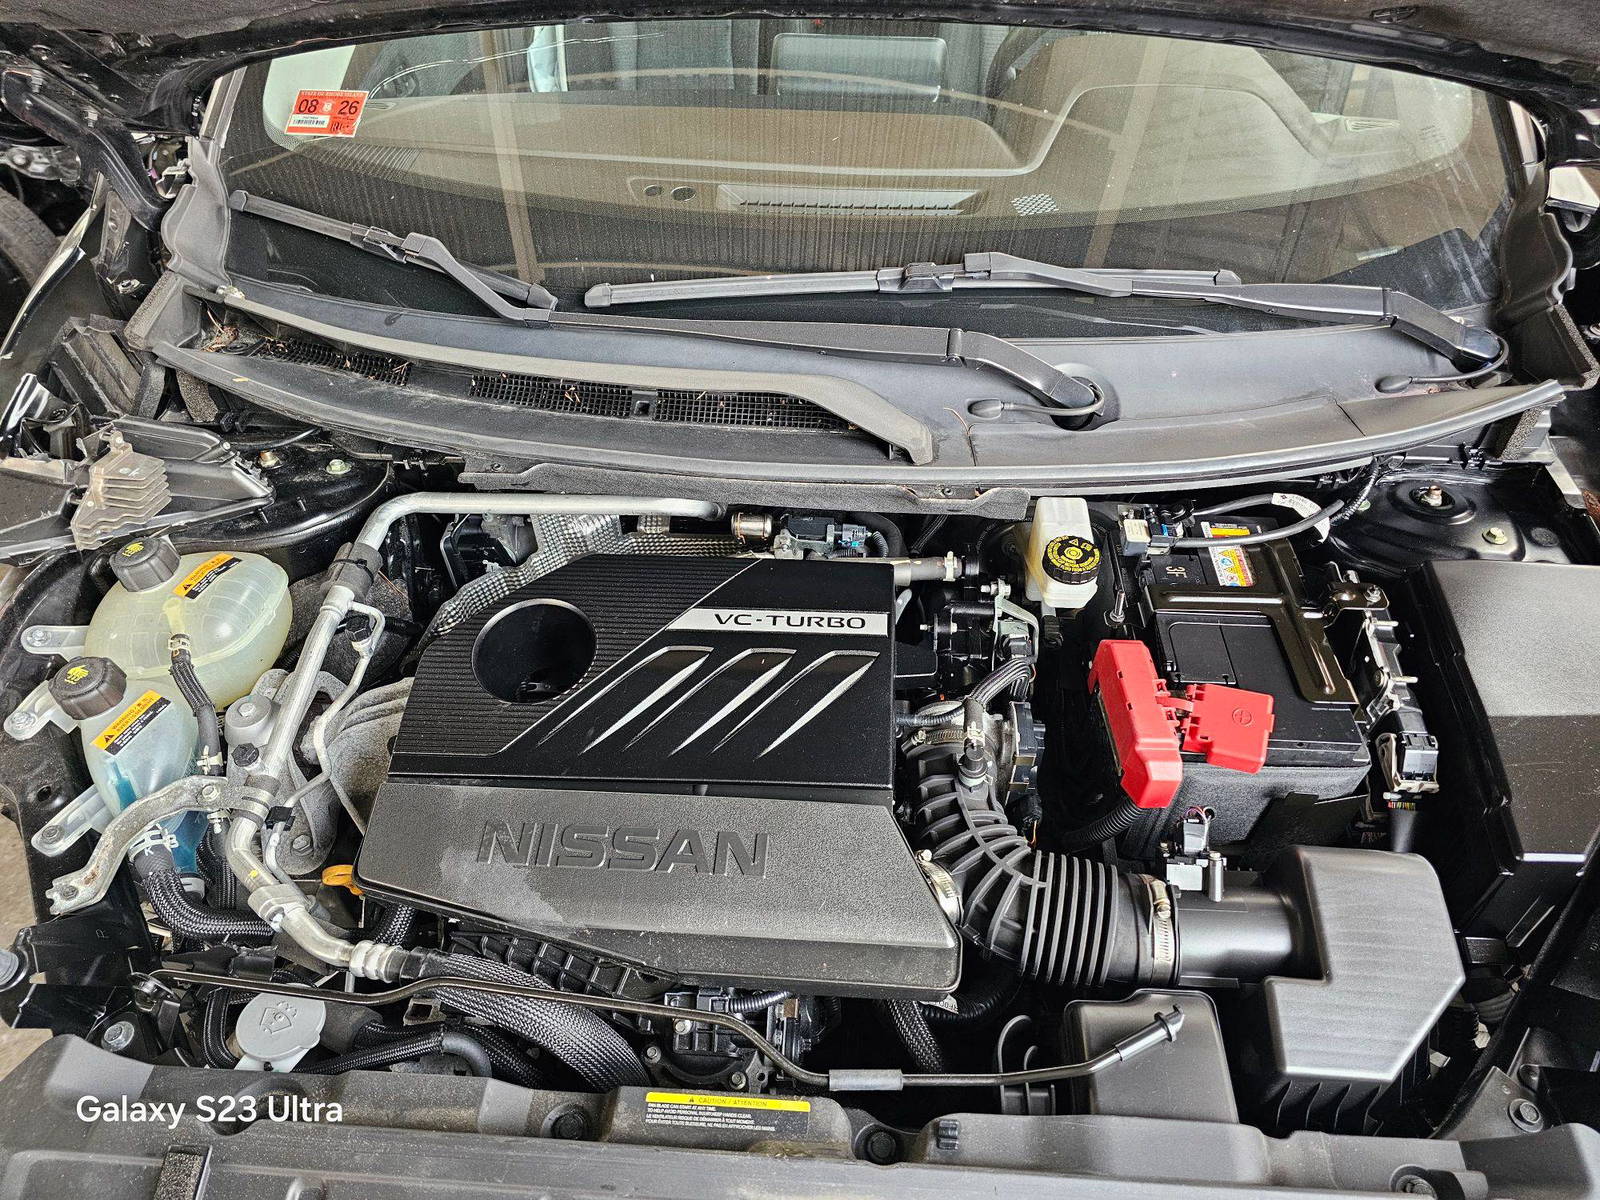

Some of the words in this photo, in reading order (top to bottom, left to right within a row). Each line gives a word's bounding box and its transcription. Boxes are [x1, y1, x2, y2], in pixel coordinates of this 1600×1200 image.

[298, 99, 319, 113] 08
[338, 100, 359, 114] 26
[714, 614, 866, 629] VC-TURBO
[476, 820, 769, 878] NISSAN
